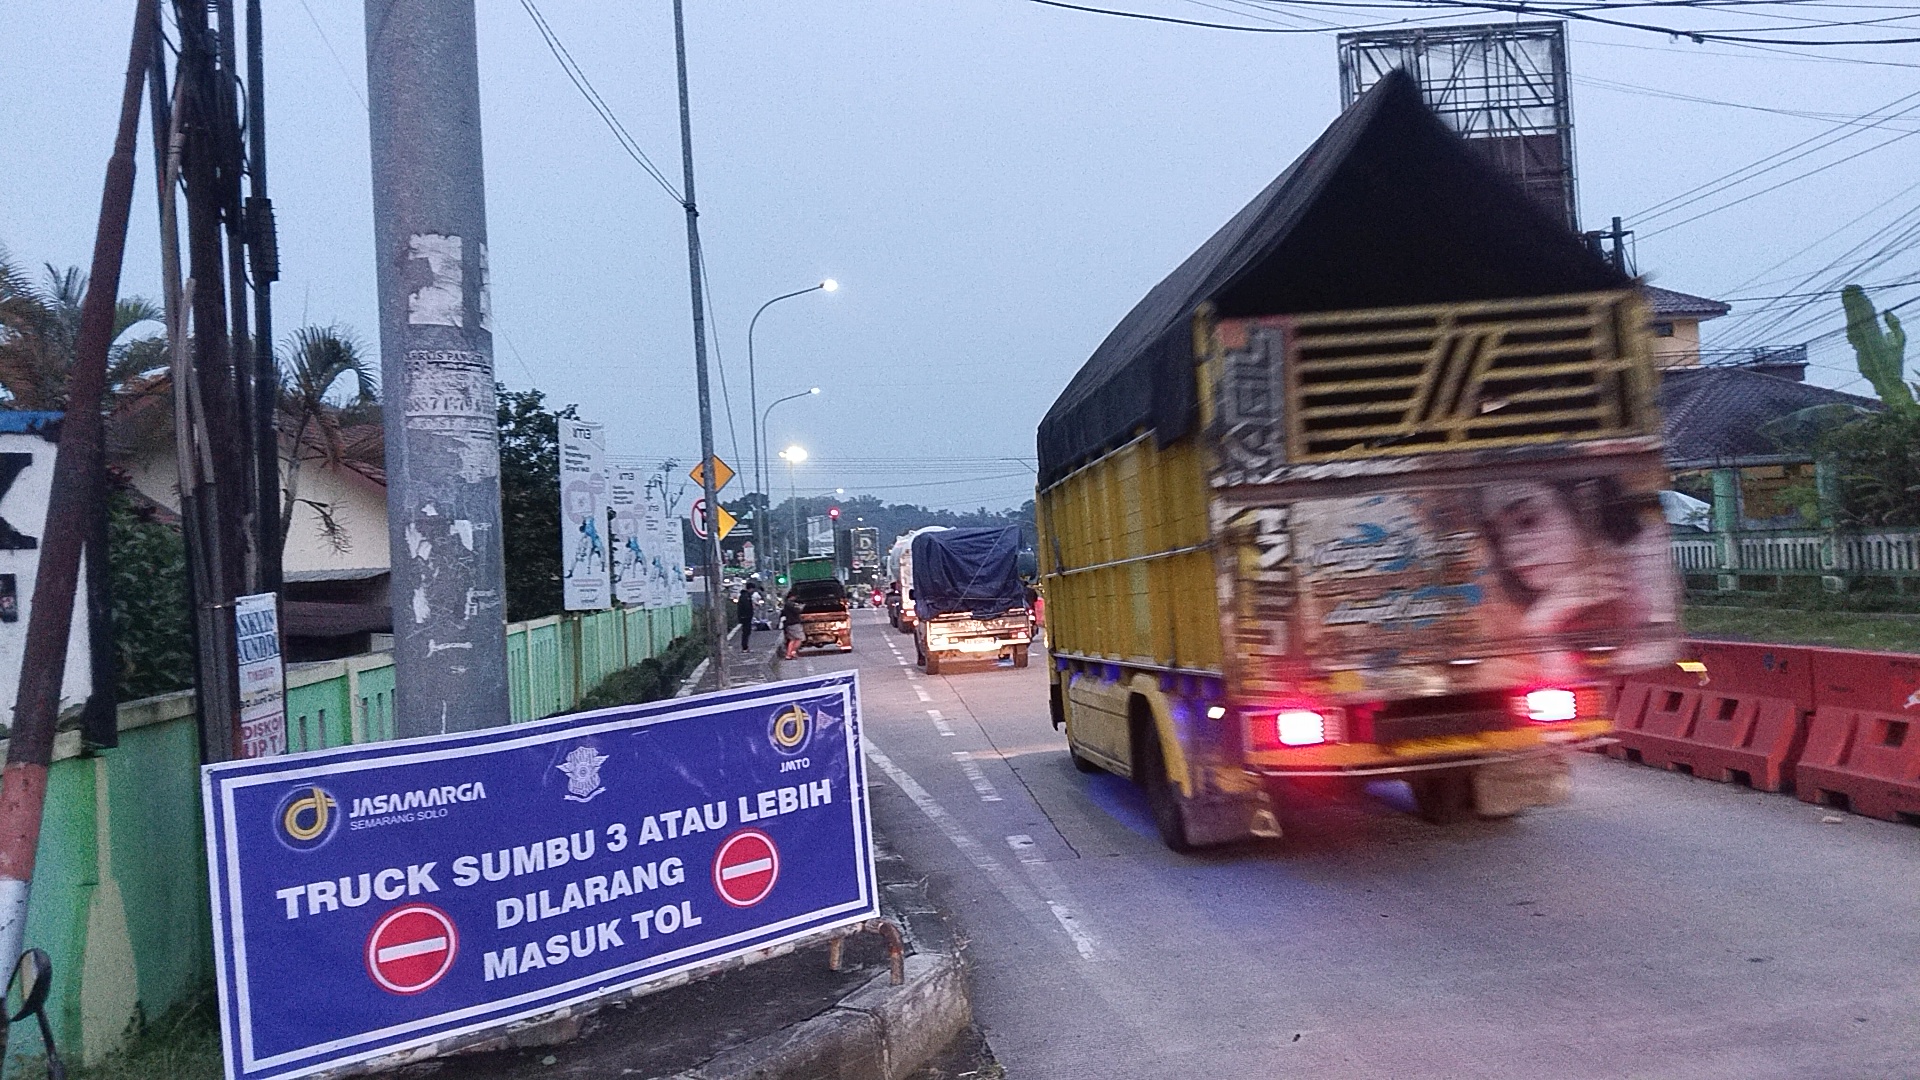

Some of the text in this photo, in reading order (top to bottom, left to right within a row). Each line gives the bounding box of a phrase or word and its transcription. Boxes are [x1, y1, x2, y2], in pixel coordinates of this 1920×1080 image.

[780, 757, 810, 773] JMTO
[349, 781, 487, 818] JASAMARGA
[350, 808, 449, 831] SEMARANG SOLO
[276, 779, 832, 919] TRUCK SUMBU 3 ATAU LEBIH
[496, 856, 685, 930] DILARANG
[483, 900, 703, 982] MASUK TOL
